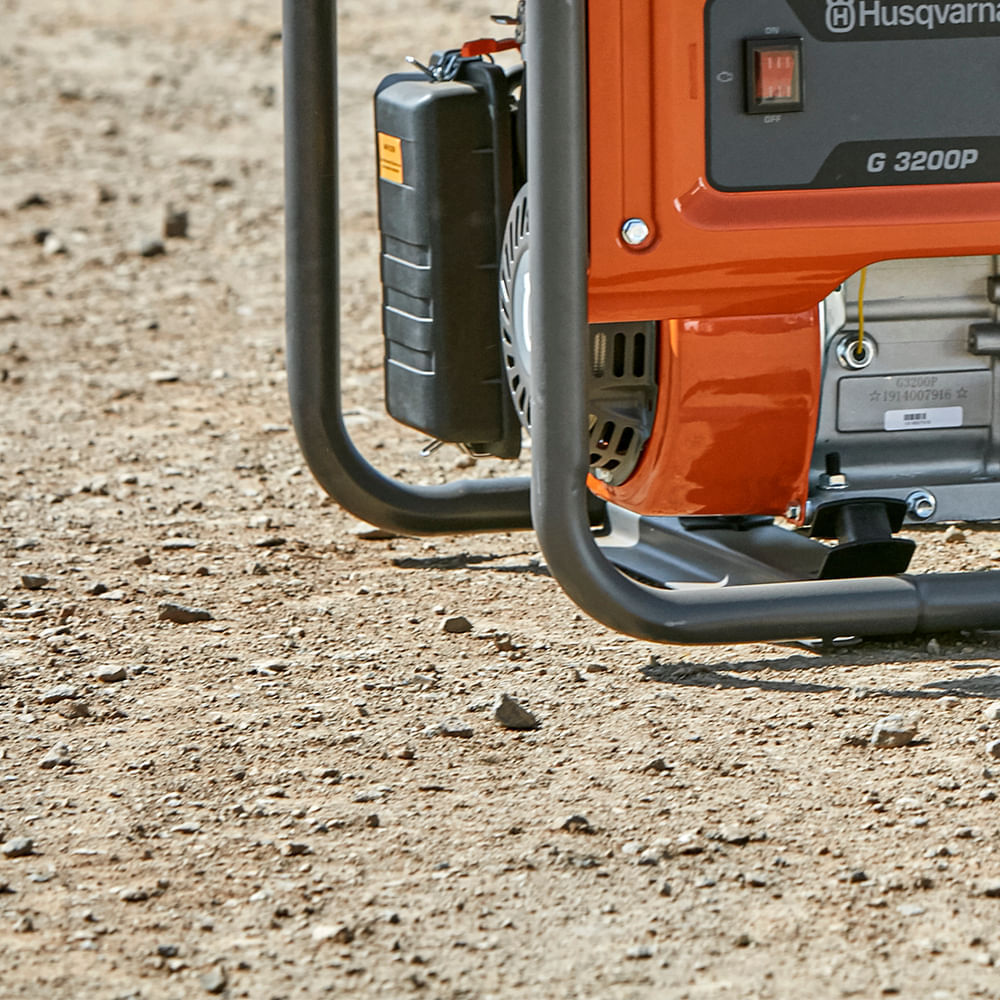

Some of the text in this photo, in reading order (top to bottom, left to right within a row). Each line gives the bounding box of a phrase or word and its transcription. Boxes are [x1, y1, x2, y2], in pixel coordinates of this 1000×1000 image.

[764, 26, 780, 35] ON
[764, 115, 781, 124] OFF
[867, 149, 979, 173] G 3200P
